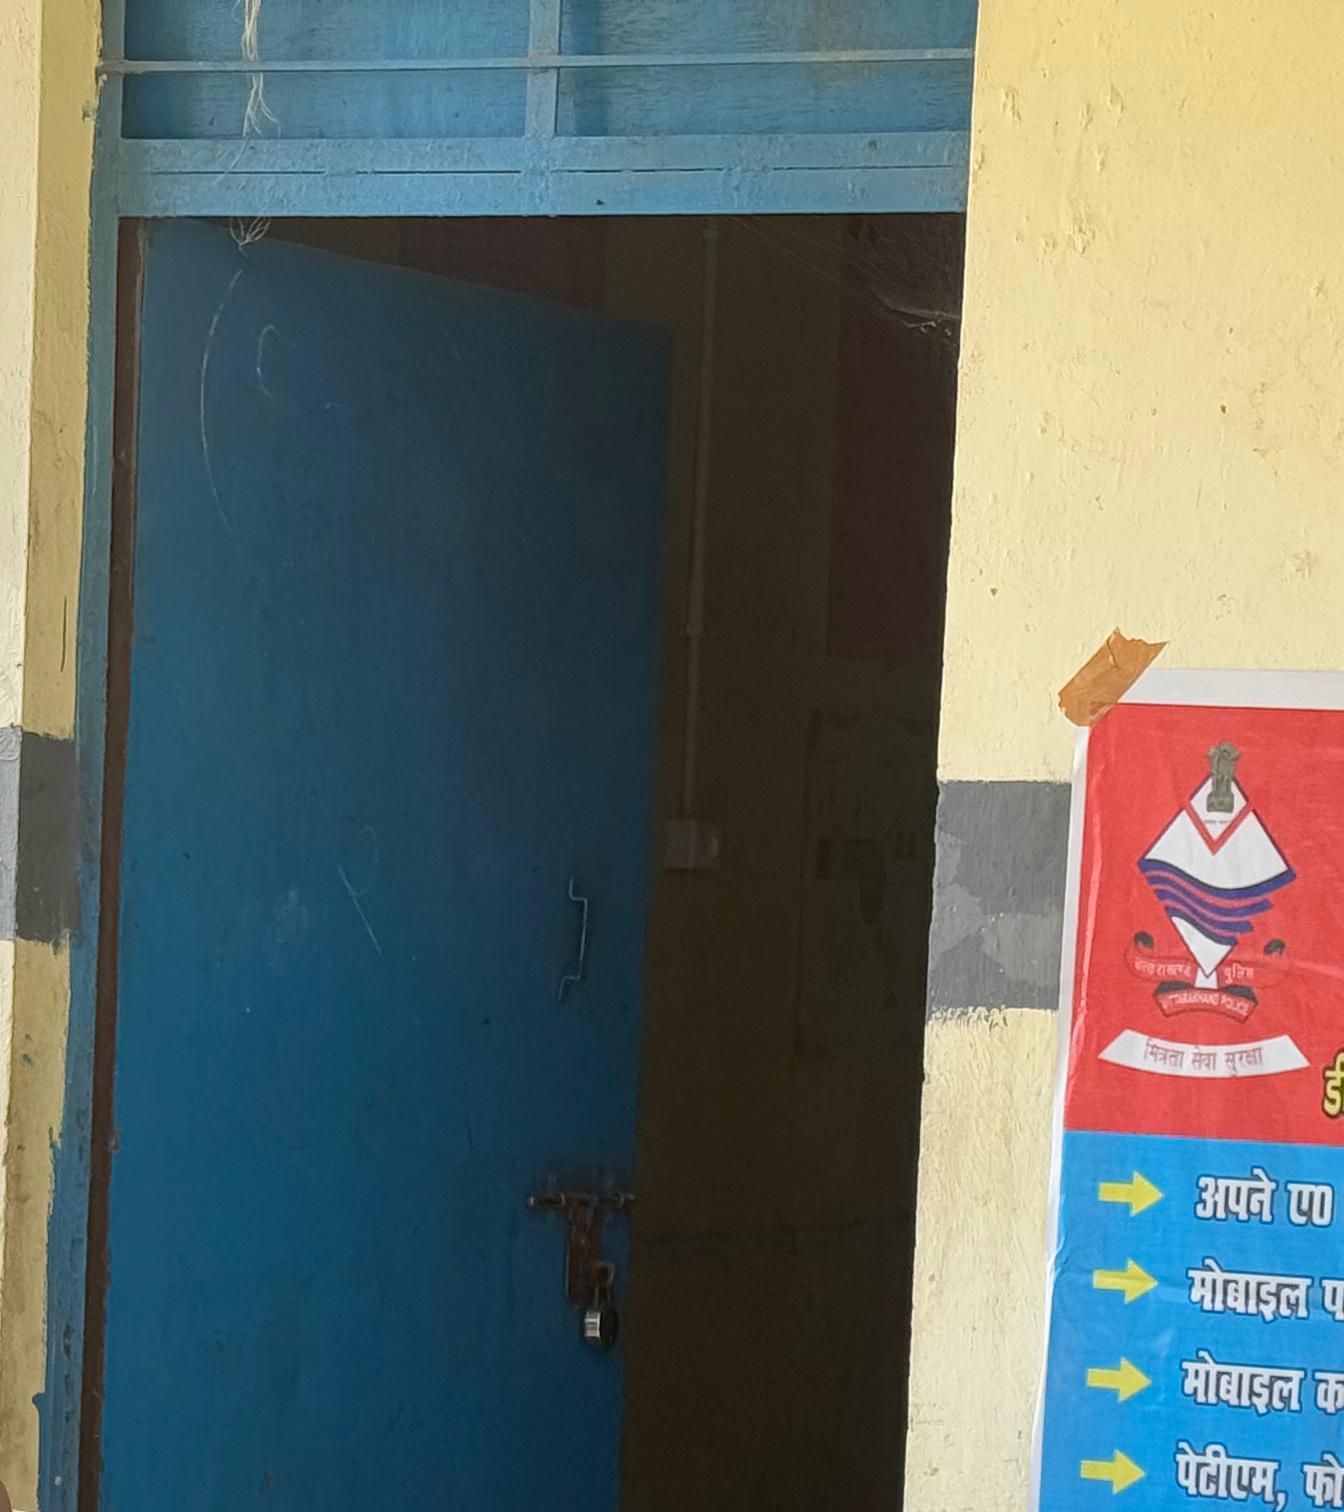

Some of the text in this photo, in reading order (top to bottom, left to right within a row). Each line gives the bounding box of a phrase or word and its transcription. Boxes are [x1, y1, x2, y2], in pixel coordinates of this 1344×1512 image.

[1196, 1168, 1277, 1222] अपने
[1188, 1258, 1312, 1321] मोबाइल
[1182, 1350, 1305, 1414] मोबाइल
